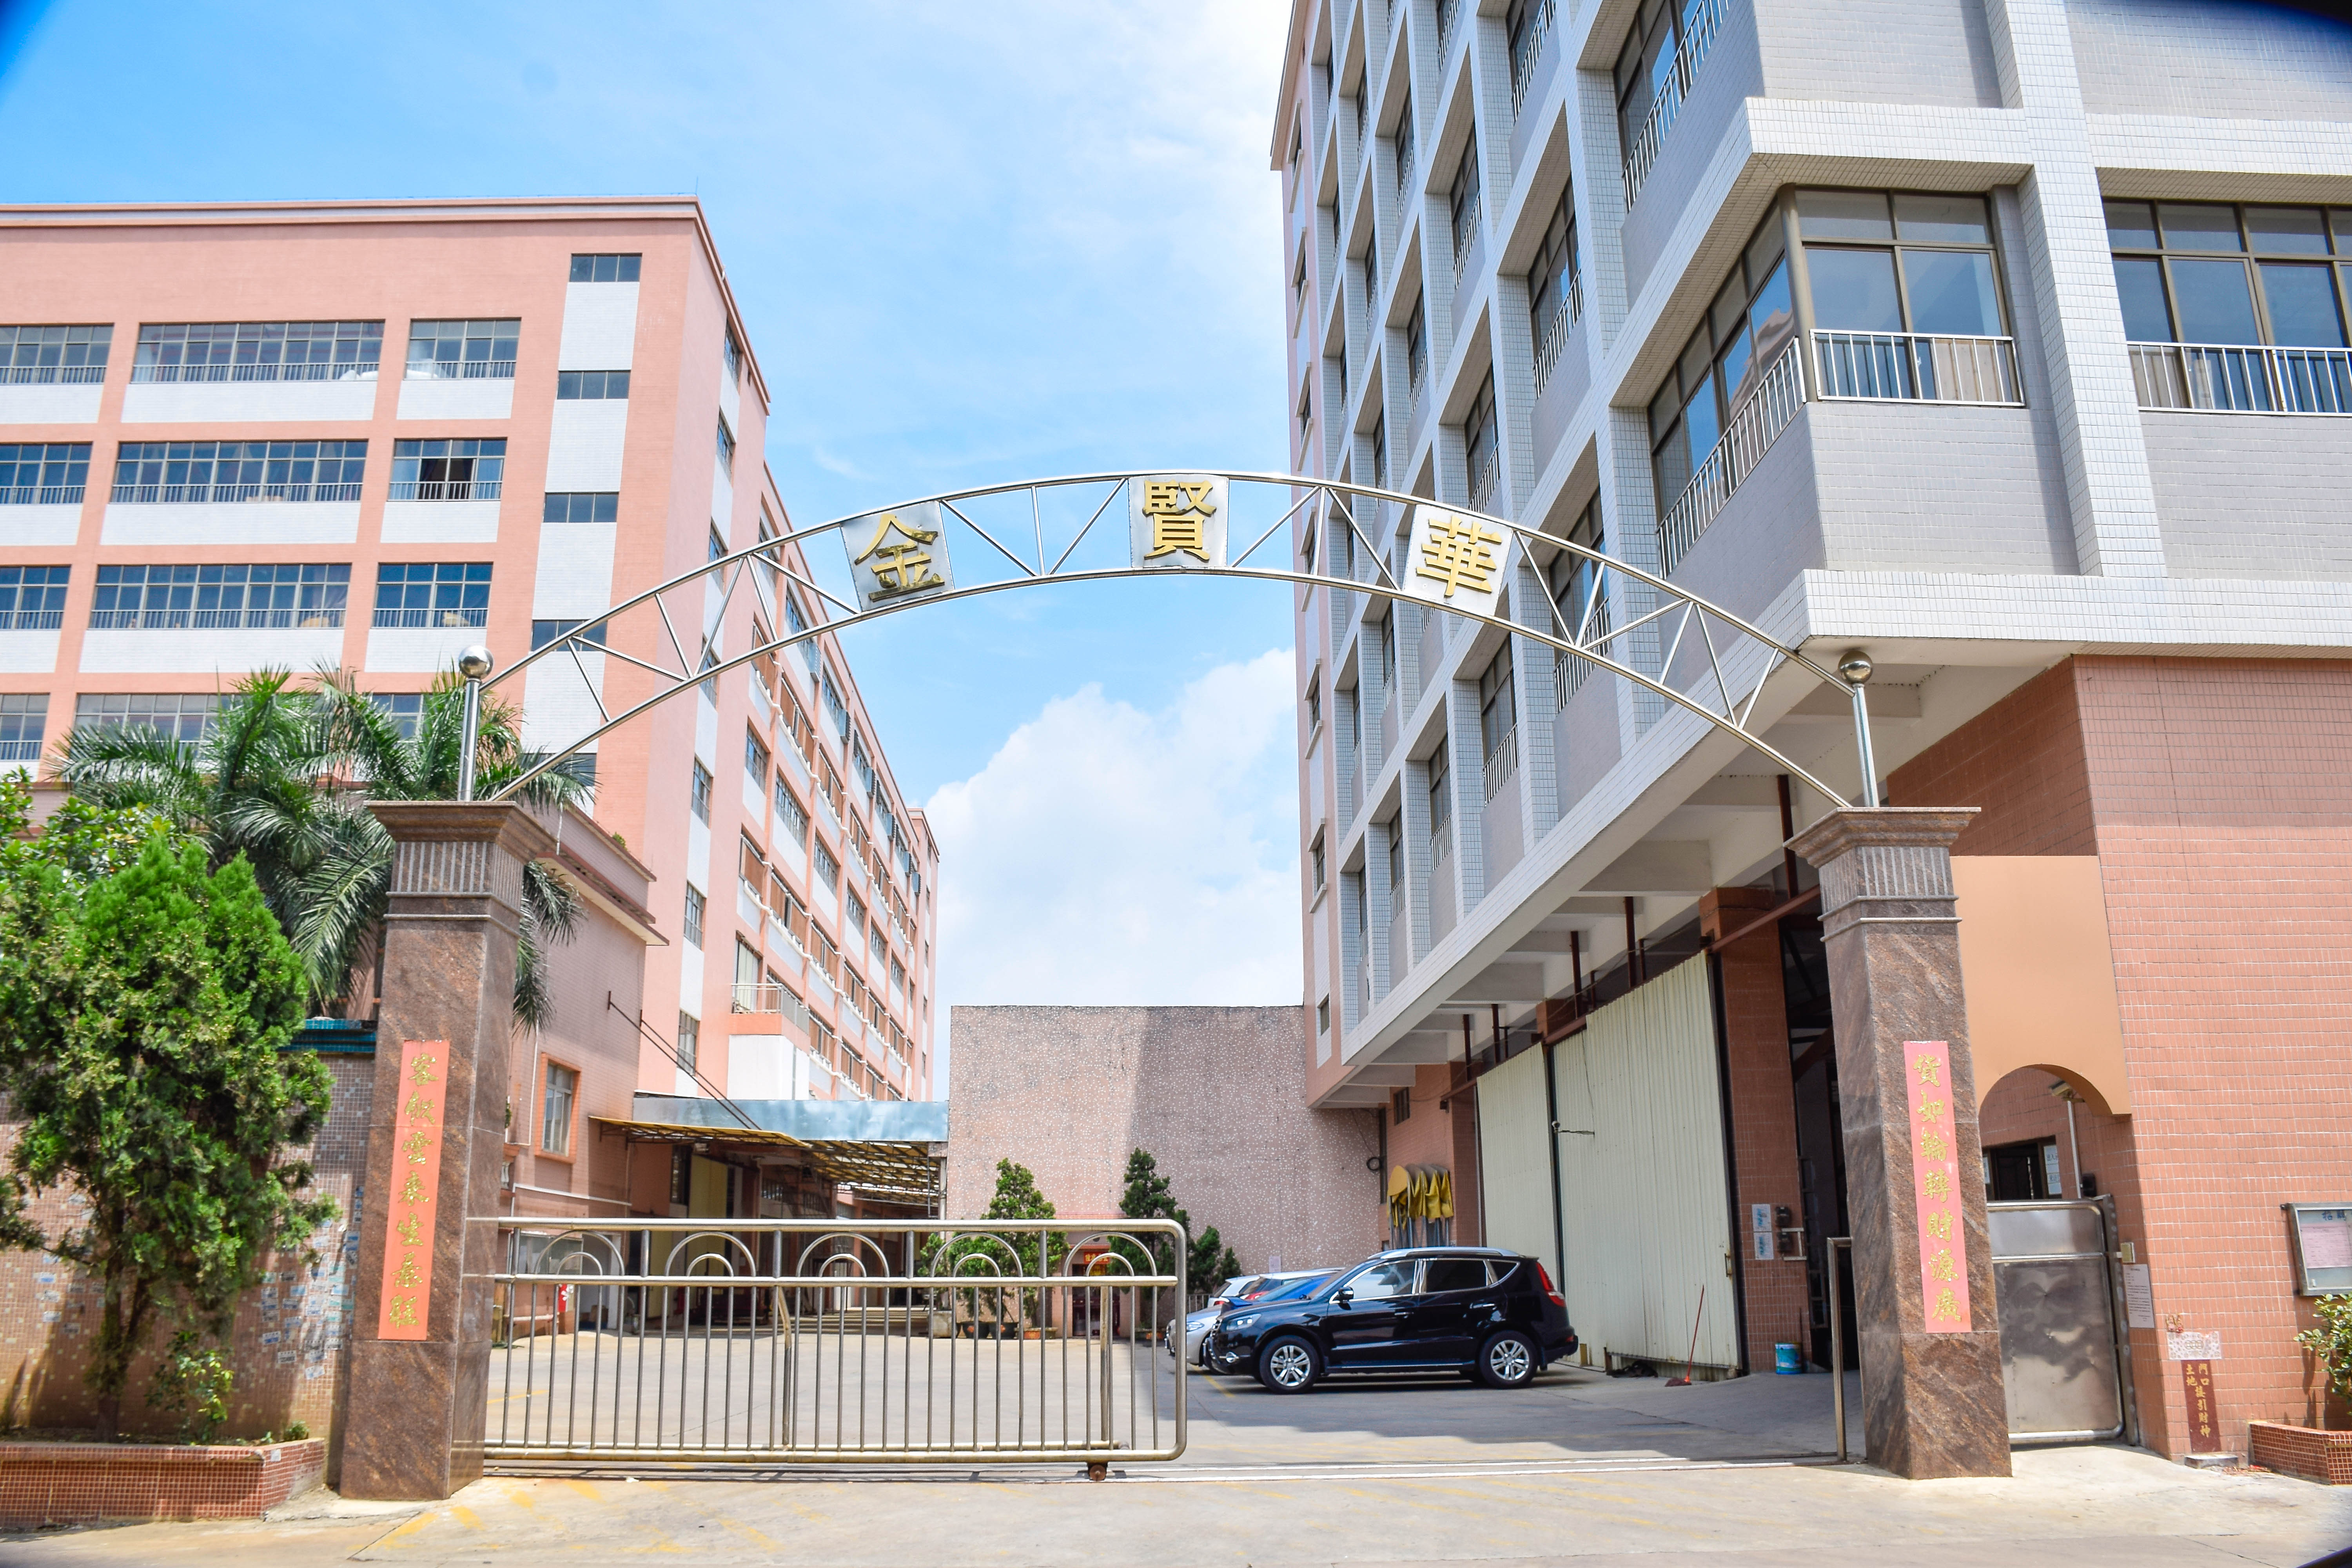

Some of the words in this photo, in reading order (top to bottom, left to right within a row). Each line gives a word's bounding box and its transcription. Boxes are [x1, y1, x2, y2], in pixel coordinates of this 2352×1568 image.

[1913, 1054, 1962, 1322] 貨如輪轉財源廣
